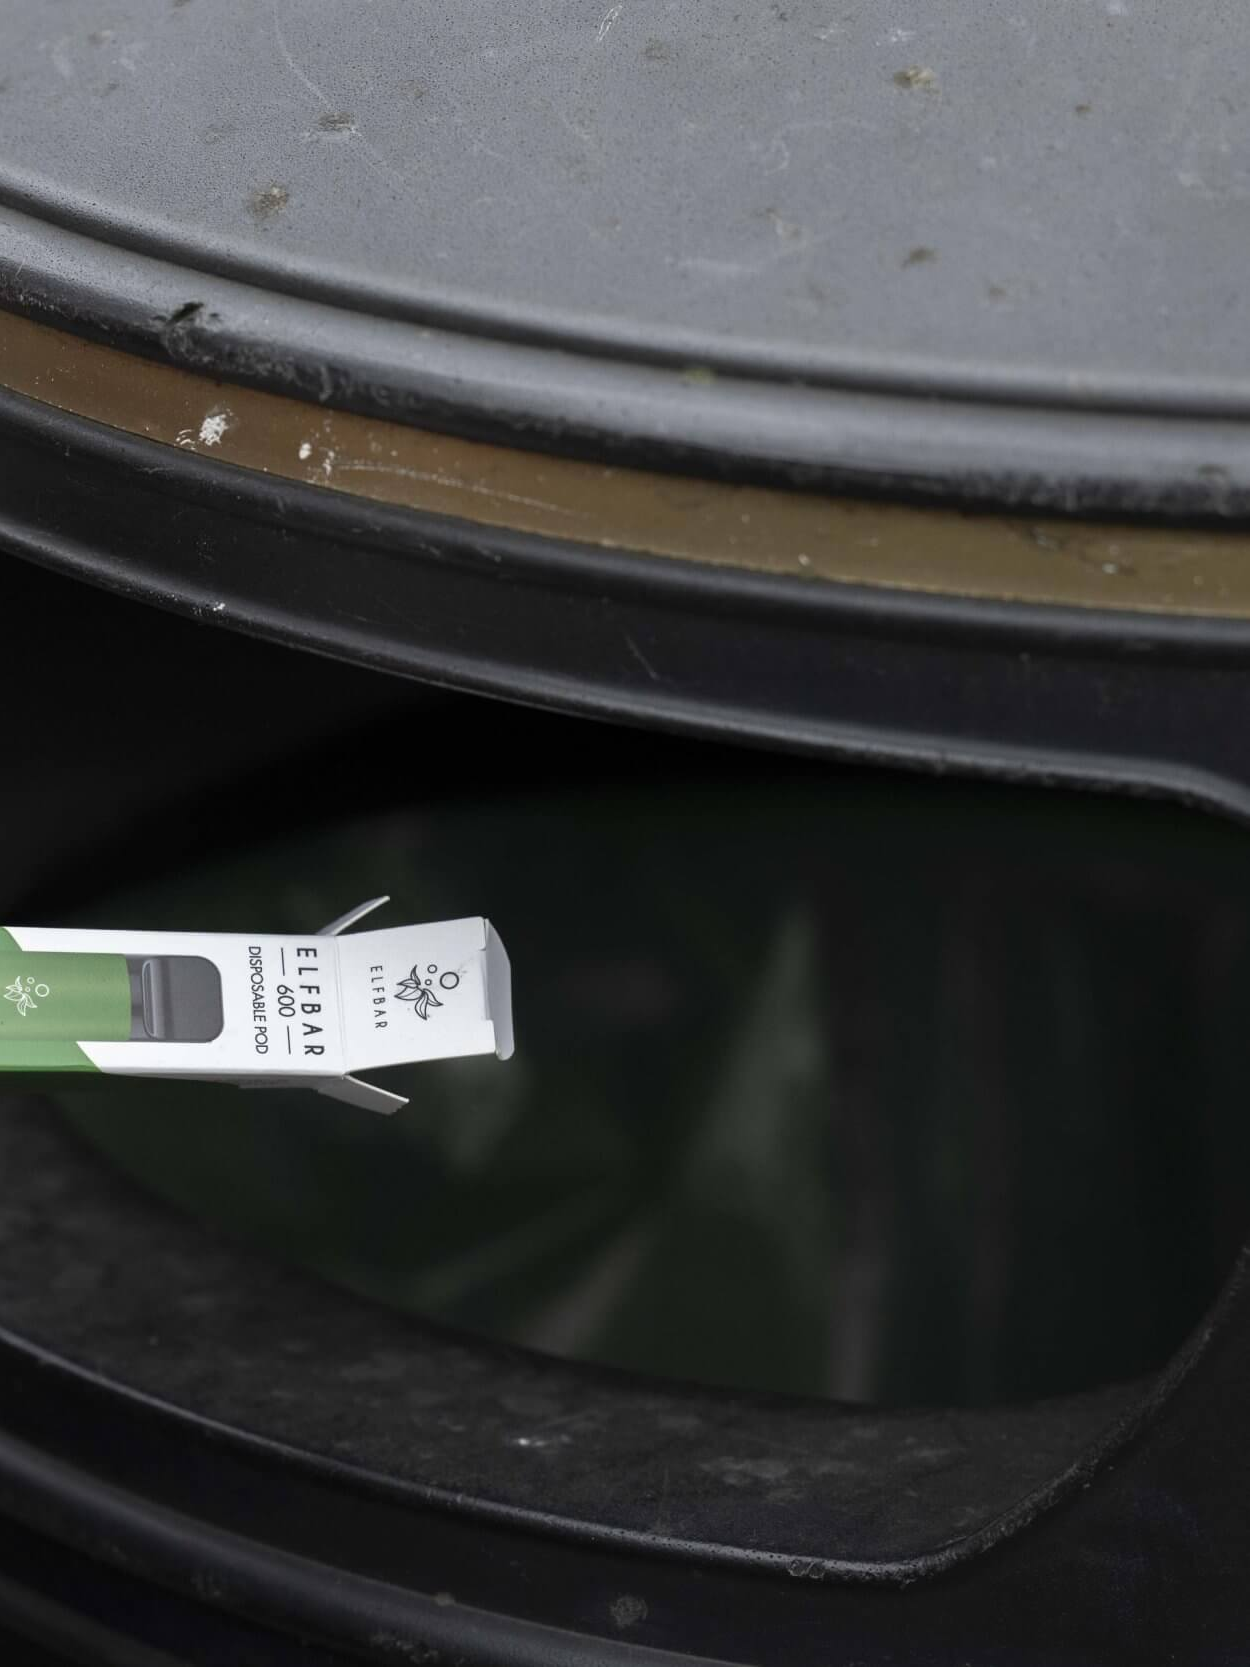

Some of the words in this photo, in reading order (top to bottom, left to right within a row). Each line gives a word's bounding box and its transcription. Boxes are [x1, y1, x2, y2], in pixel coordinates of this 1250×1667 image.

[248, 946, 267, 1022] DISPOSABLE
[276, 984, 296, 1018] 600
[296, 947, 325, 1056] ELFBAR
[369, 965, 388, 1029] ELFBAR
[254, 1026, 269, 1055] POD
